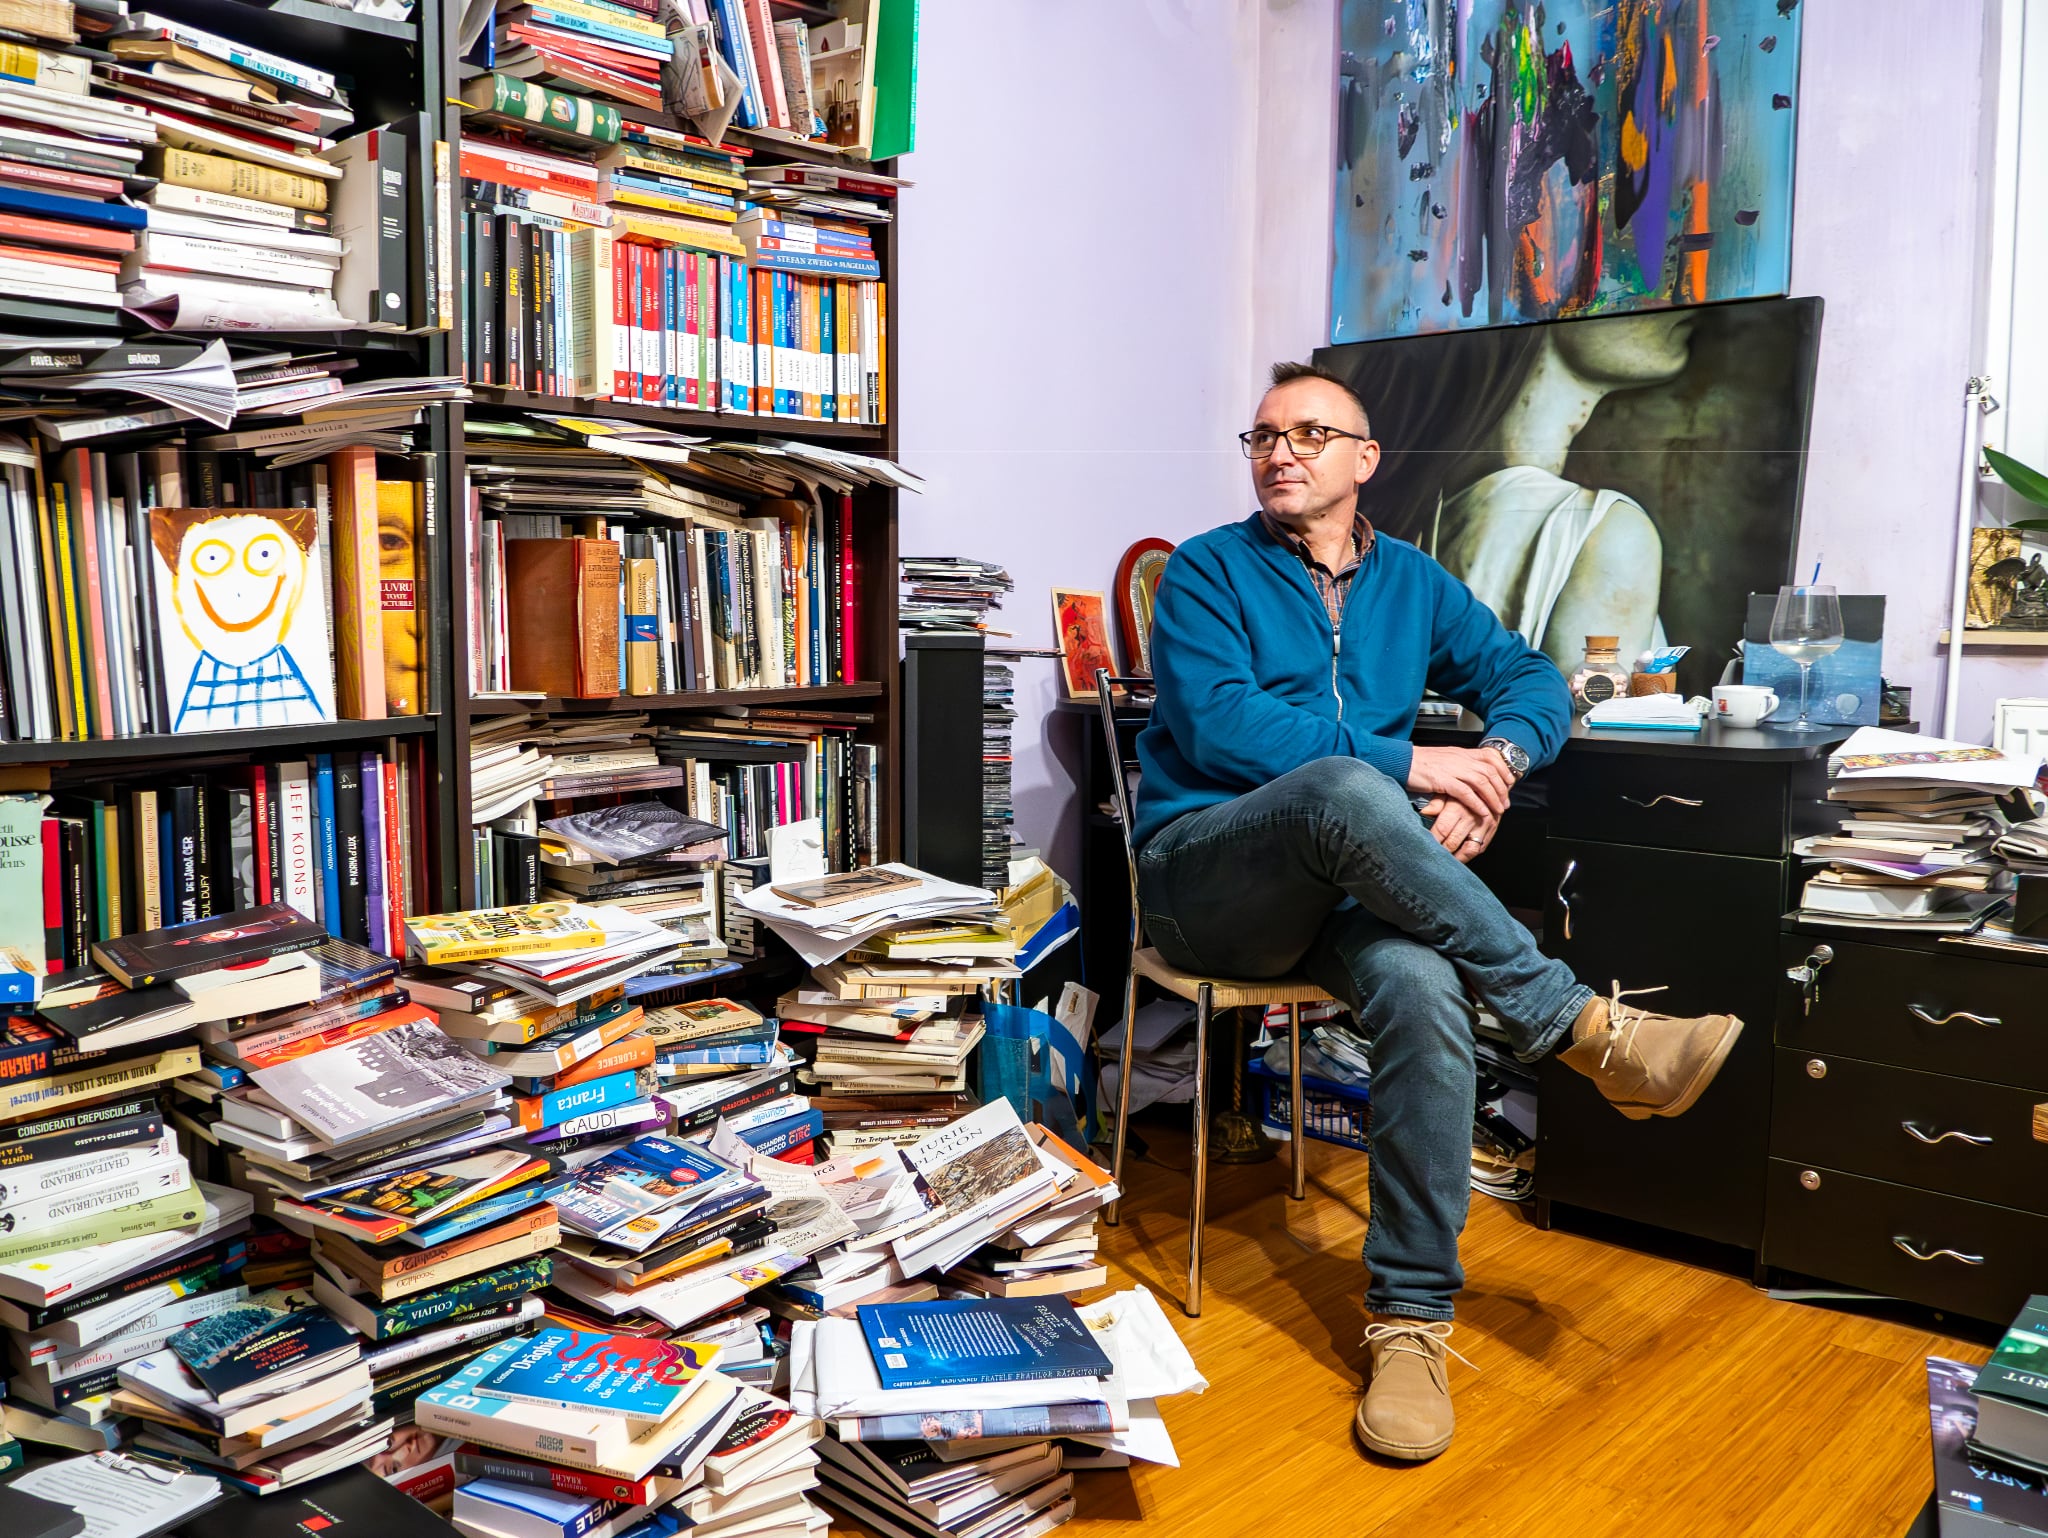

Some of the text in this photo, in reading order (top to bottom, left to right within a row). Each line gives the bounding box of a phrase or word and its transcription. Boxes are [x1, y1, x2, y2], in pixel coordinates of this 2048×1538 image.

[776, 255, 876, 271] STEFAN ZWEIG MAGELLAN
[30, 354, 53, 367] PAVEL
[380, 582, 412, 592] LUVRU
[289, 783, 307, 896] JEFF KOONS
[525, 854, 536, 885] sexuală
[199, 874, 210, 898] DUFY
[246, 1037, 277, 1052] BENJAMIN
[278, 1026, 302, 1043] WALTER
[597, 1051, 637, 1070] FLORENCE
[8, 1063, 156, 1107] MARIO VARGAS LLOSA Eroul discret
[77, 1103, 142, 1126] CREPUSCULARE
[564, 1110, 619, 1135] GAUDÍ
[74, 1128, 139, 1147] ROBERTO CALASSO
[788, 1127, 811, 1145] CIRC
[854, 1136, 867, 1144] The
[899, 1133, 921, 1141] Gallery
[920, 1123, 970, 1154] IURIE
[1, 1152, 34, 1165] NUNTA
[914, 1128, 983, 1169] PLATON
[40, 1157, 130, 1190] CHATEAUBRIAND
[48, 1186, 140, 1219] CHATEAUBRIAND
[20, 1232, 98, 1254] CUM SE SCRIE ISTORIA
[697, 1221, 737, 1246] MARCUS AURELIUS
[495, 1278, 534, 1294] Eve Chase
[410, 1300, 453, 1321] COLIVIA
[480, 1307, 499, 1319] JERZY
[245, 1334, 277, 1351] Adrian
[514, 1334, 566, 1371] Drăghici
[543, 1359, 580, 1385] Un râs
[570, 1361, 600, 1384] ca un
[583, 1363, 619, 1393] zgomot
[598, 1365, 636, 1400] de sticle
[627, 1367, 658, 1395] sparte
[727, 1417, 767, 1441] SOVIANY
[731, 1420, 779, 1447] OCTAVIAN
[535, 1441, 564, 1454] ANDREI
[538, 1435, 564, 1446] BODIU
[483, 1463, 535, 1481] Eurotrash
[550, 1473, 582, 1484] KRACHT
